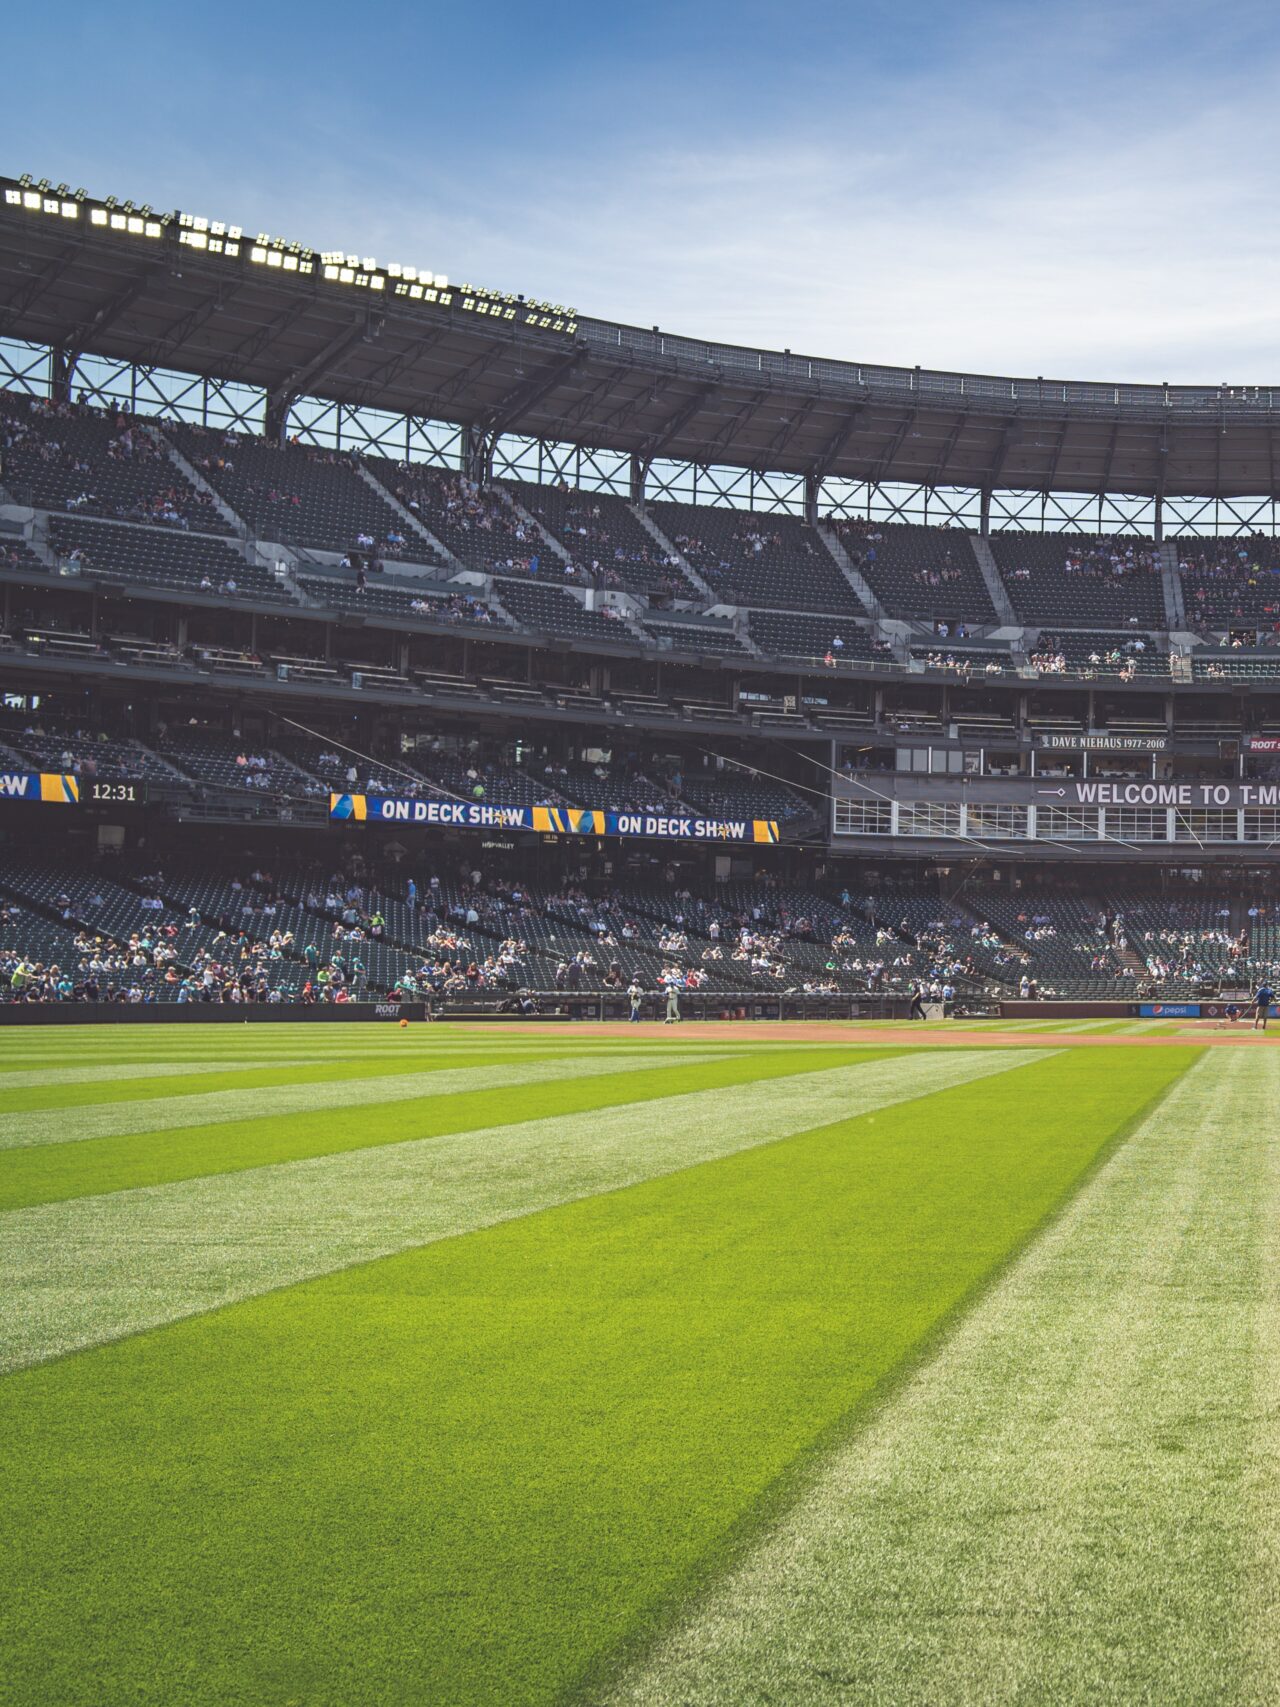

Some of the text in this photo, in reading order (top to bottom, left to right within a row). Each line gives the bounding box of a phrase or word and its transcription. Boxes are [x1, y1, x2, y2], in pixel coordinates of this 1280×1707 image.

[1052, 737, 1077, 747] DAVE
[1080, 738, 1121, 749] NIEHAUS
[1251, 741, 1277, 749] ROOT
[93, 783, 136, 801] 12:31
[1076, 783, 1192, 805] WELCOME
[1200, 785, 1230, 805] TO
[382, 800, 409, 819] ON
[414, 802, 465, 823] DECK
[618, 816, 642, 833] ON
[646, 818, 691, 836] DECK
[375, 1004, 401, 1013] ROOT
[1165, 1006, 1186, 1015] pepsi
